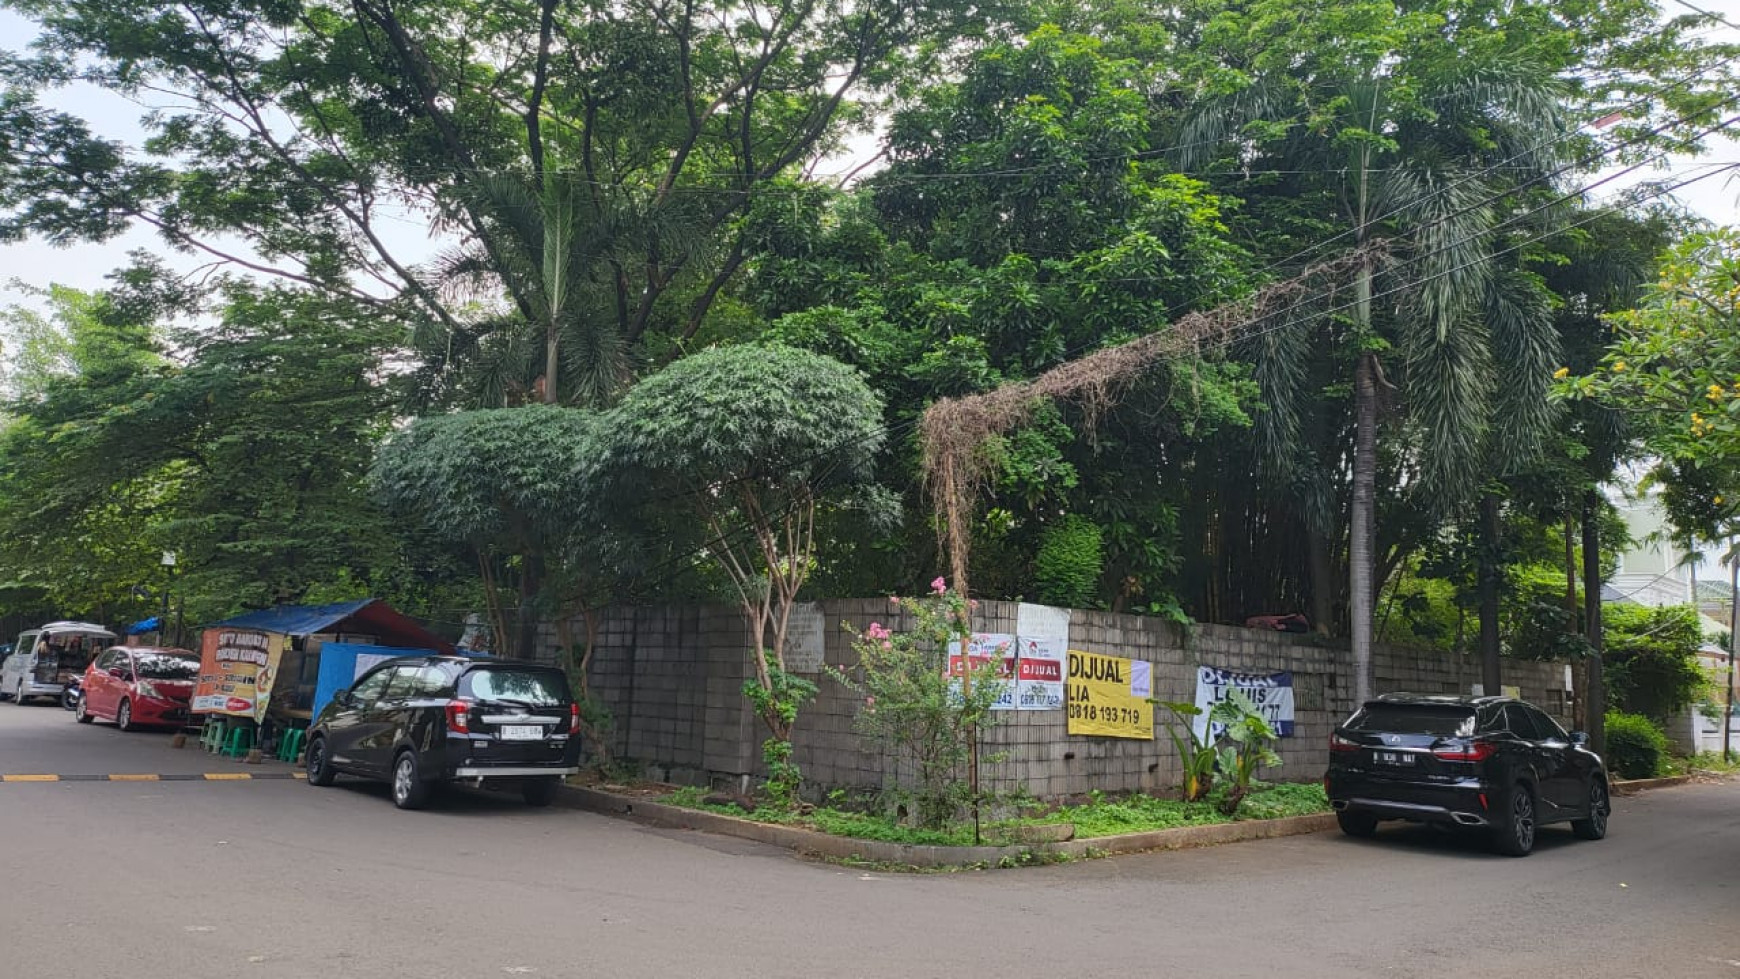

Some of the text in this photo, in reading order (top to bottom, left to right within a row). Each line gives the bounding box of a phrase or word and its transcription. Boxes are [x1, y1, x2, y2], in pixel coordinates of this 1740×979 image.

[1022, 664, 1057, 676] DIJUAL
[1069, 653, 1124, 683] DIJUAL
[1201, 667, 1279, 687] DIUAL
[1069, 684, 1090, 702] LIA
[1069, 703, 1140, 724] 0818 193 719
